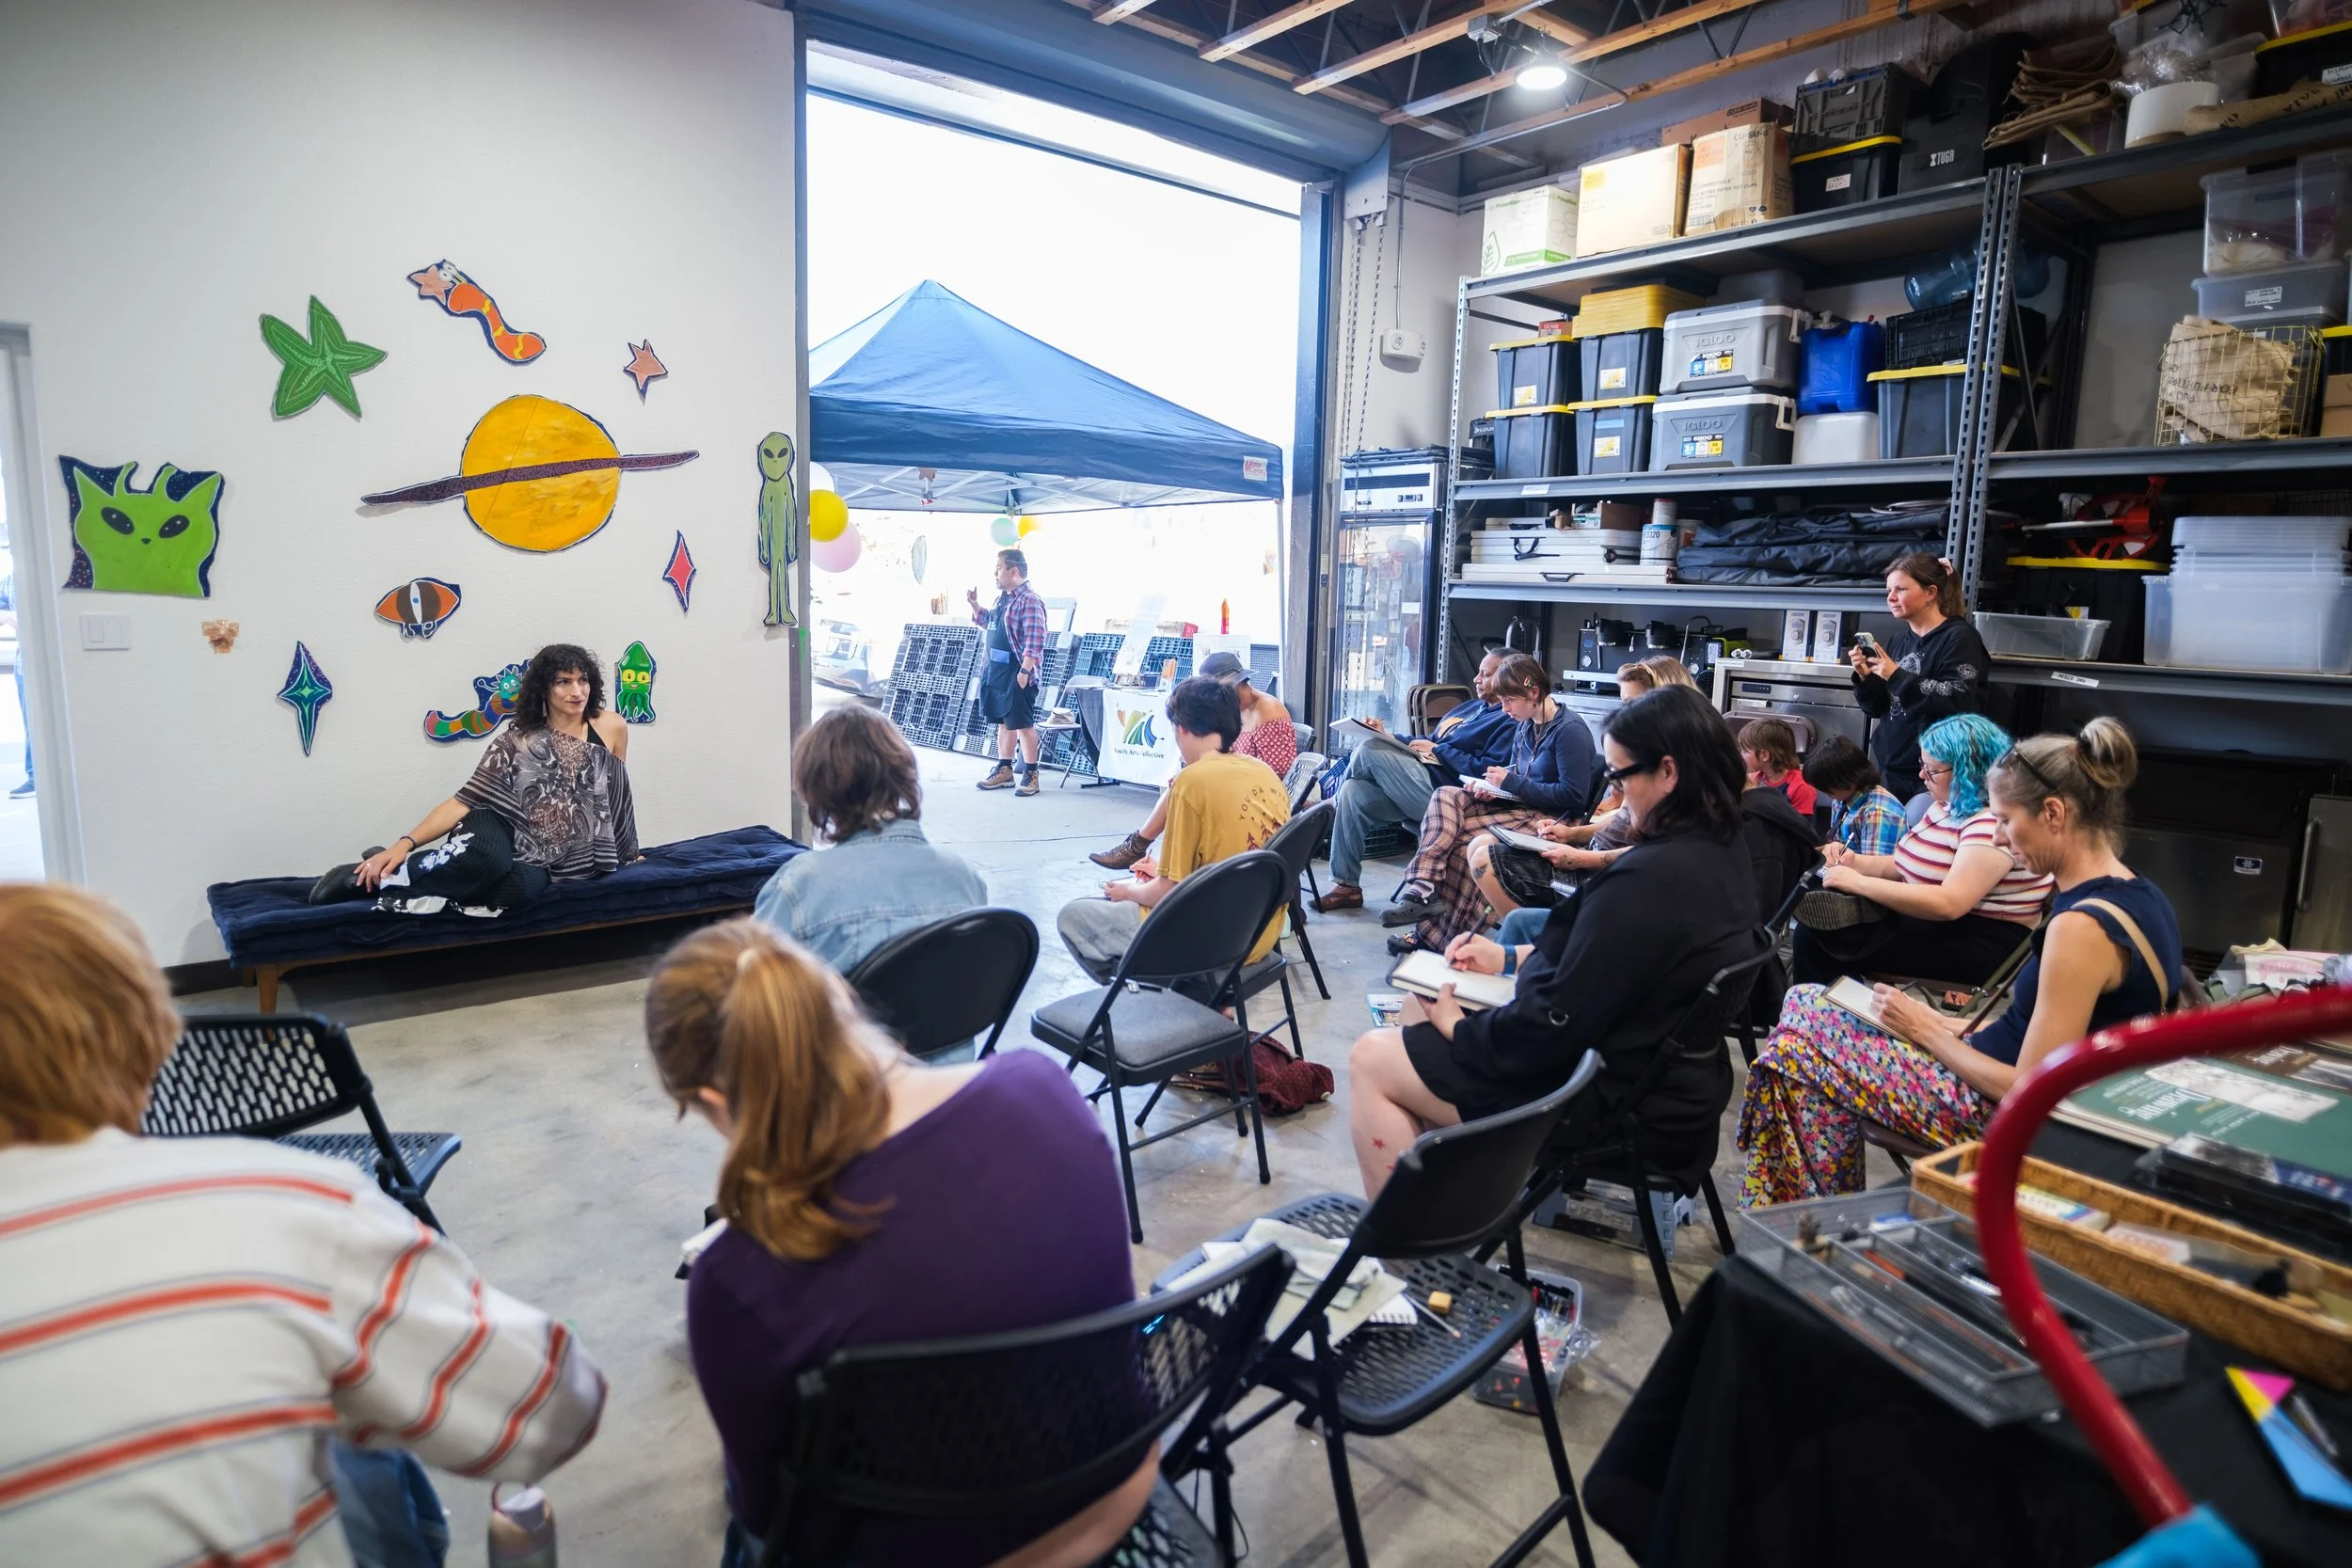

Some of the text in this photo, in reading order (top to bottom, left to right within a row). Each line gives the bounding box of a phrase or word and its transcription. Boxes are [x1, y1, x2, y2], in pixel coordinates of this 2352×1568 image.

[1696, 334, 1736, 347] IGLOO
[1684, 420, 1723, 431] IGLOO
[1646, 531, 1661, 539] 3320
